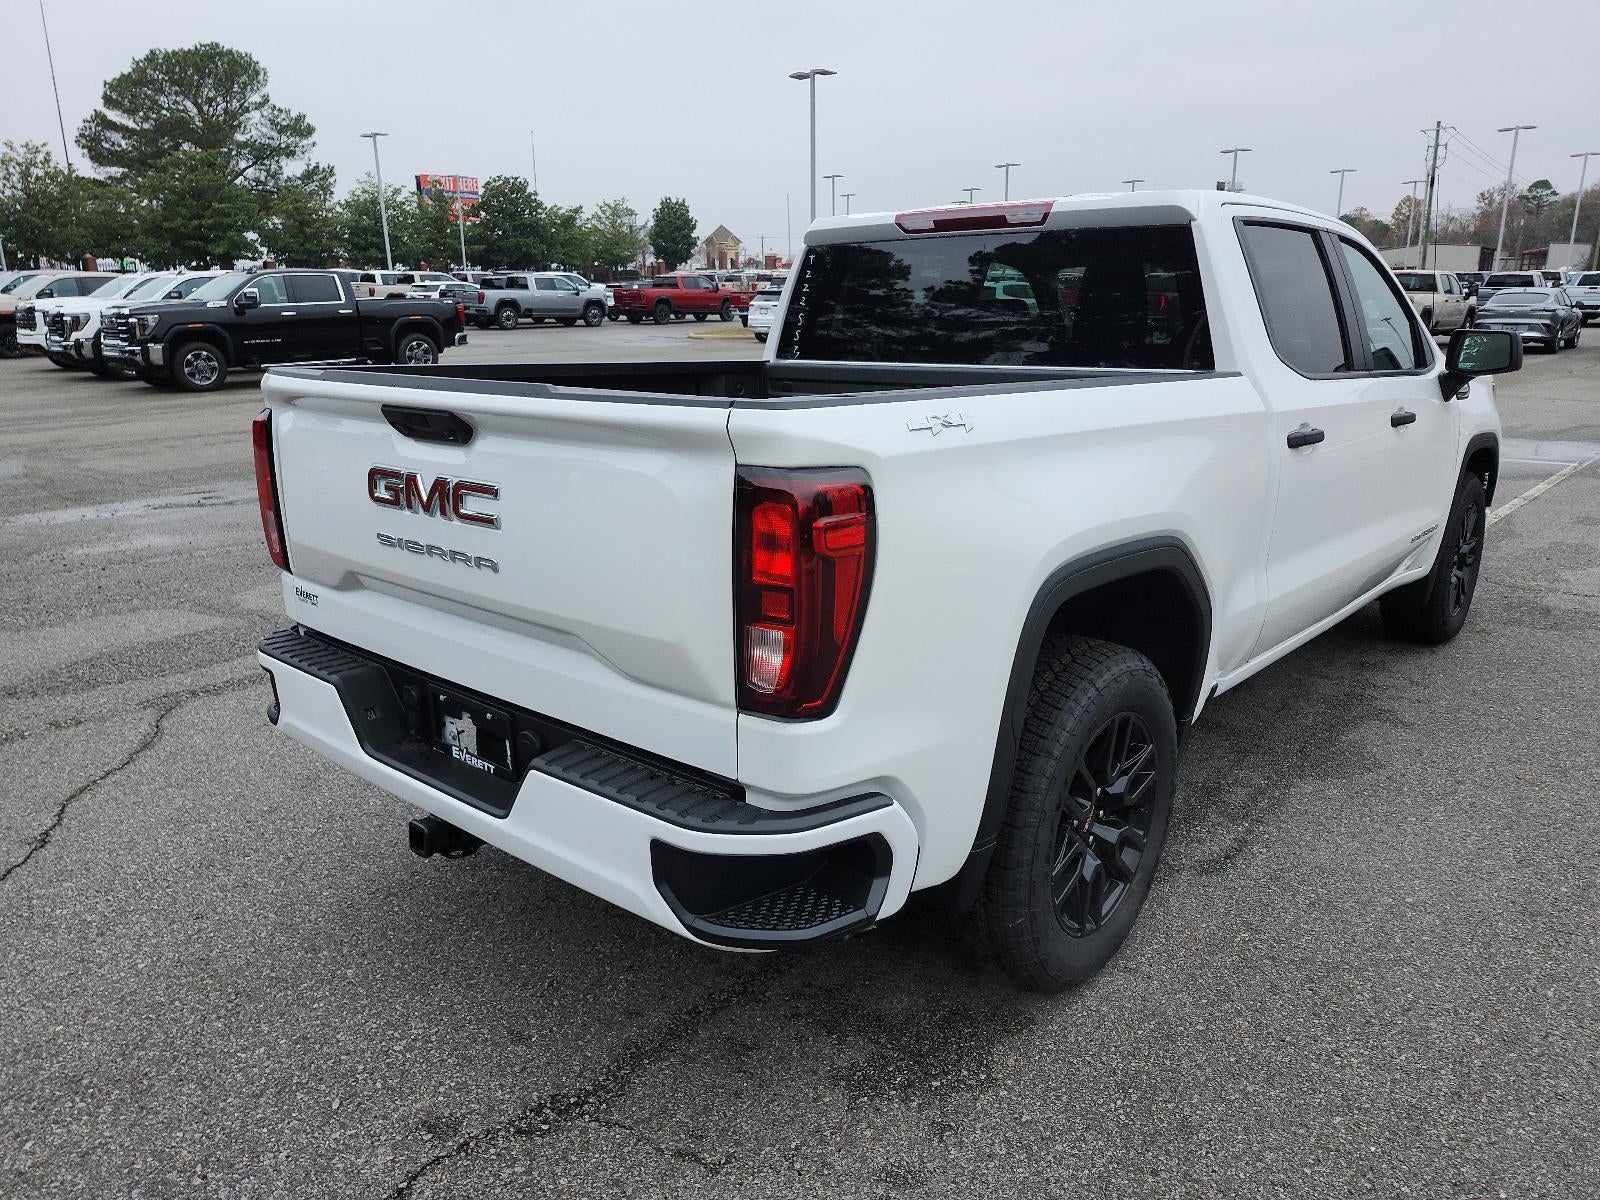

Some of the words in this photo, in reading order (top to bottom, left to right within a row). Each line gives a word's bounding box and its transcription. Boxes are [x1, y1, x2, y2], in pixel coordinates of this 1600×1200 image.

[367, 463, 502, 531] GMC
[376, 532, 500, 573] SIERRA
[451, 745, 495, 774] EVERETT
